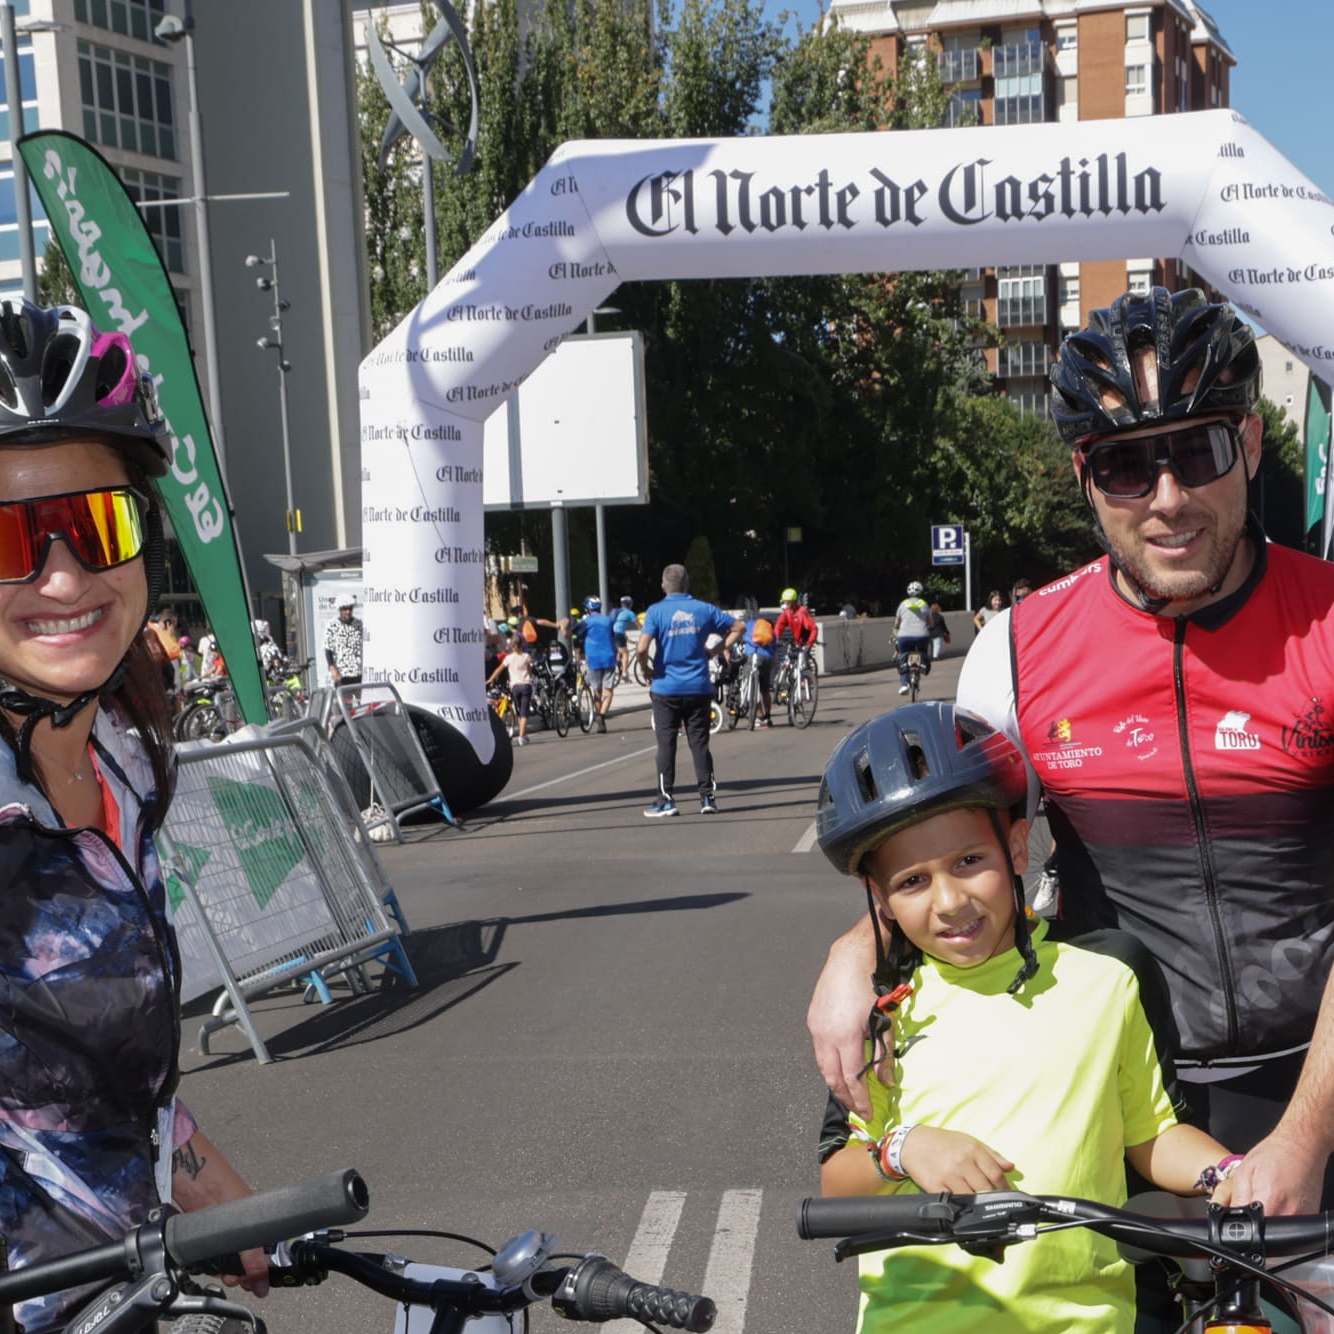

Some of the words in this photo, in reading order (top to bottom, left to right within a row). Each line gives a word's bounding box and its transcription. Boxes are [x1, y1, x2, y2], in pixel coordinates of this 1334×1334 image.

[625, 168, 700, 238] El
[710, 167, 862, 235] Norte
[869, 167, 929, 229] de
[939, 151, 1168, 226] Castilla
[1220, 183, 1240, 202] El
[1243, 183, 1280, 200] Norte
[1282, 182, 1296, 200] de
[522, 221, 576, 240] Castilla
[1195, 228, 1251, 246] Castilla
[548, 262, 568, 280] El
[570, 261, 604, 279] Norte
[1228, 268, 1245, 285] El
[1248, 267, 1284, 285] Norte
[1287, 266, 1302, 284] de
[447, 305, 465, 322] El
[467, 305, 503, 322] Norte
[505, 304, 520, 321] de
[521, 303, 573, 321] Castilla
[406, 347, 420, 364] de
[419, 347, 474, 364] Castilla
[446, 387, 465, 404] El
[467, 383, 501, 402] Norte
[411, 424, 462, 442] Castilla
[436, 466, 453, 484] El
[395, 507, 409, 523] de
[410, 505, 461, 524] Castilla
[435, 547, 452, 564] El
[395, 587, 407, 604] de
[409, 587, 460, 604] Castilla
[434, 628, 450, 645] El
[395, 668, 407, 684] de
[408, 667, 459, 684] Castilla
[438, 705, 454, 720] El
[1058, 758, 1083, 769] TORO
